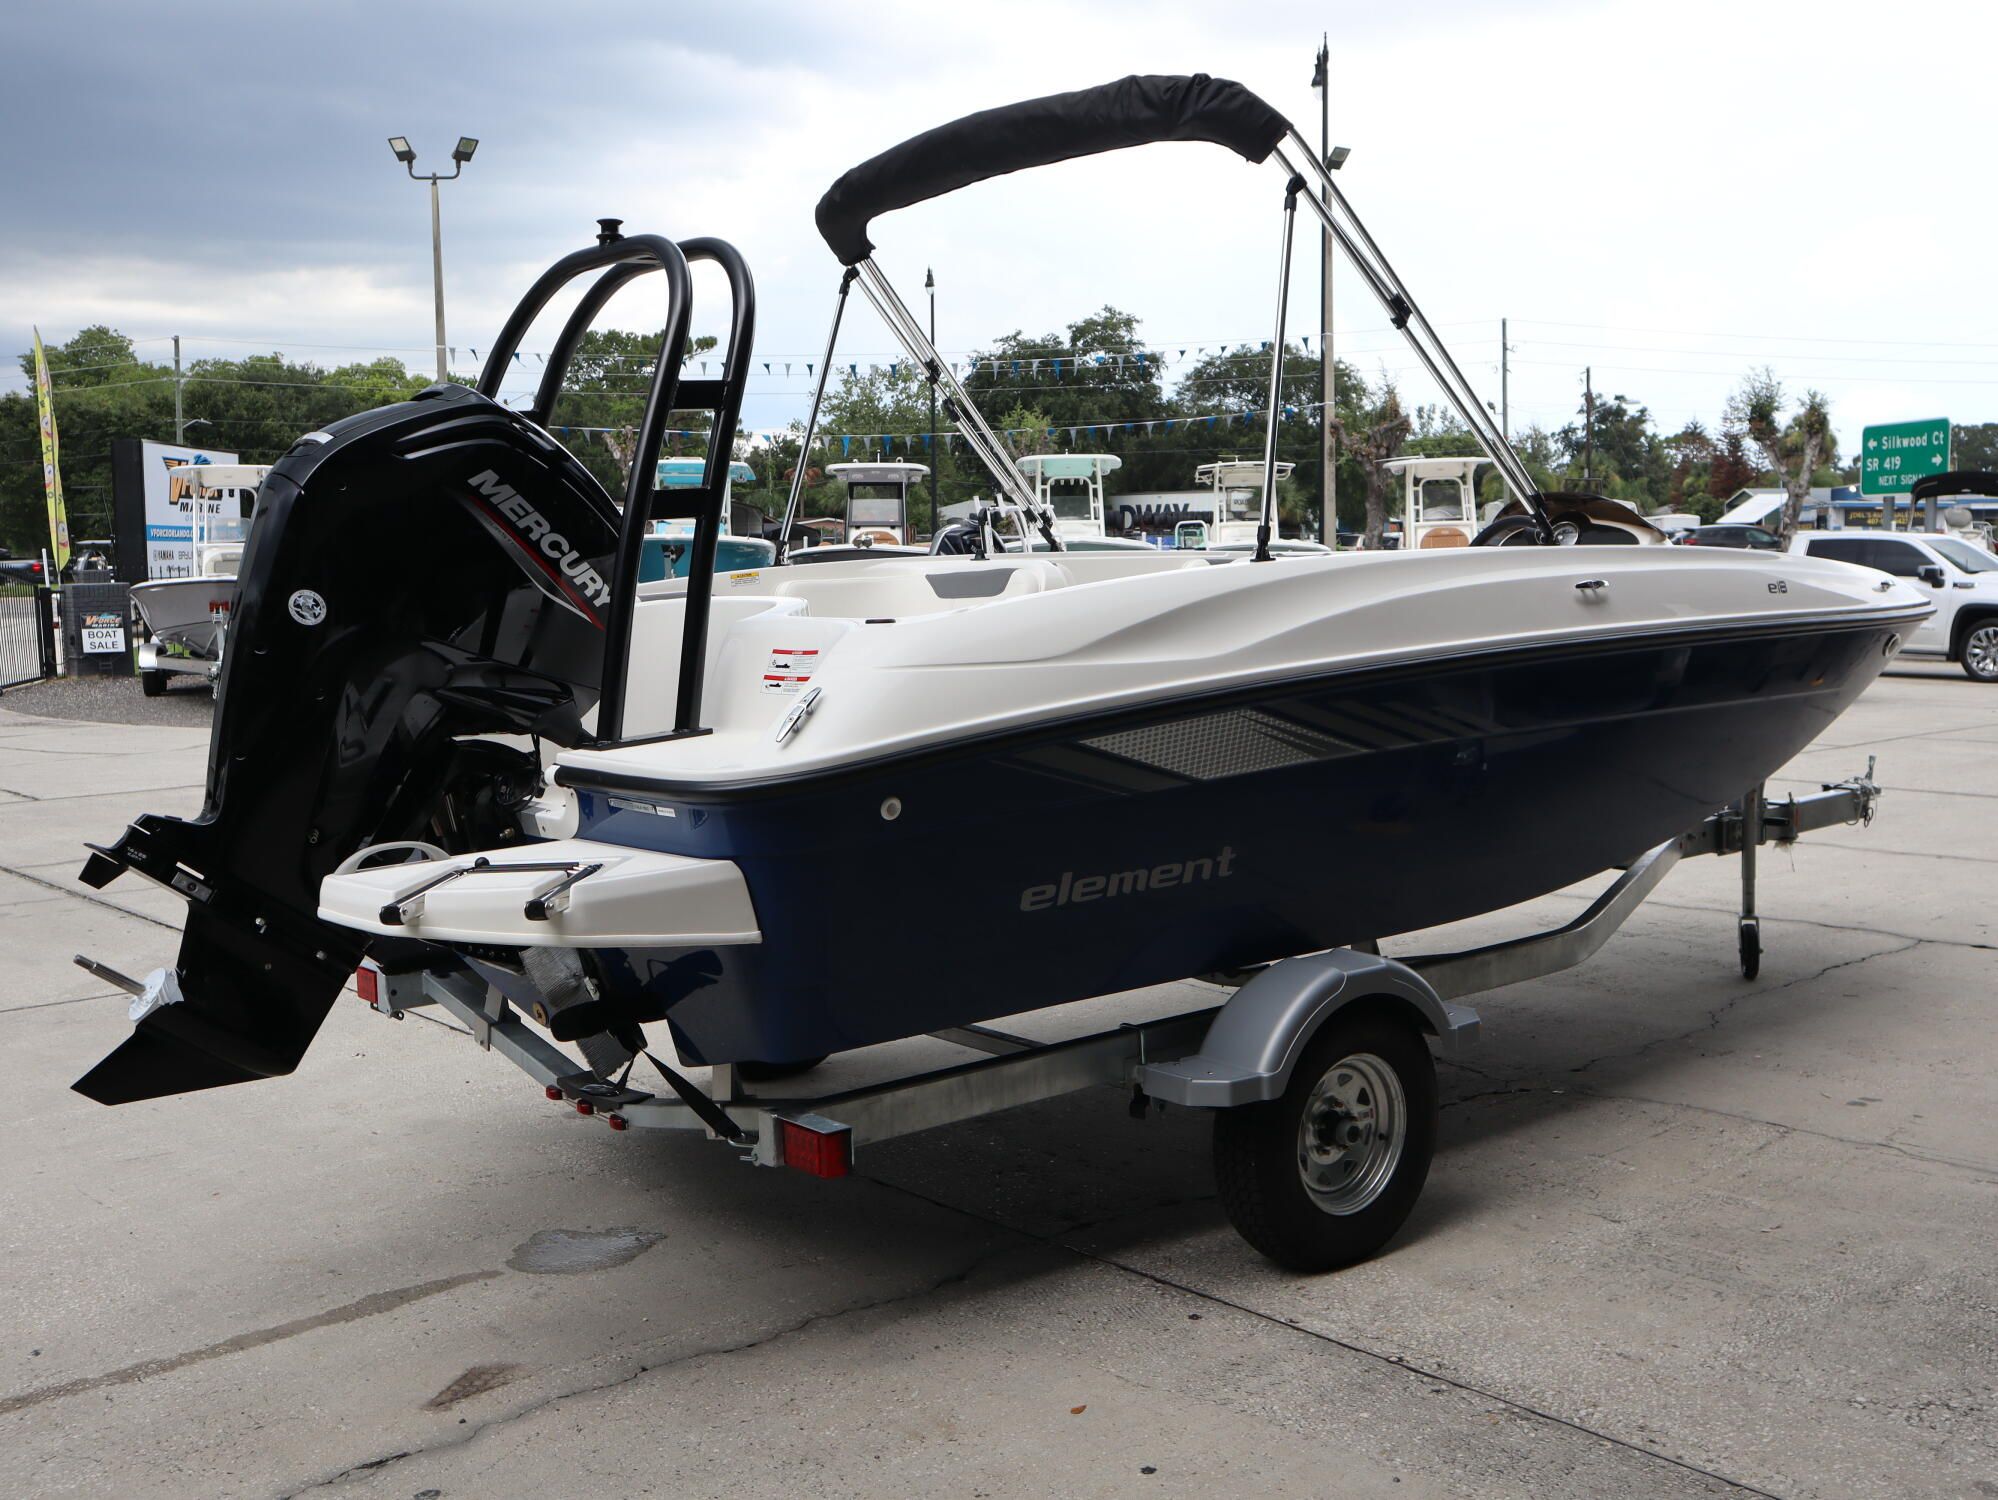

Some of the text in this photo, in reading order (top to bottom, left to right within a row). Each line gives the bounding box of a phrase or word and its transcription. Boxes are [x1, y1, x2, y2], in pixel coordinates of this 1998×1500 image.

[1881, 431, 1945, 450] Silkwood Ct
[1866, 456, 1902, 472] SR 419
[1878, 473, 1926, 486] NEXT SIGN
[179, 502, 222, 514] MARNE
[467, 469, 611, 608] MERCURY
[88, 630, 118, 639] BOAT
[89, 640, 120, 649] SALE
[1019, 846, 1237, 912] element
